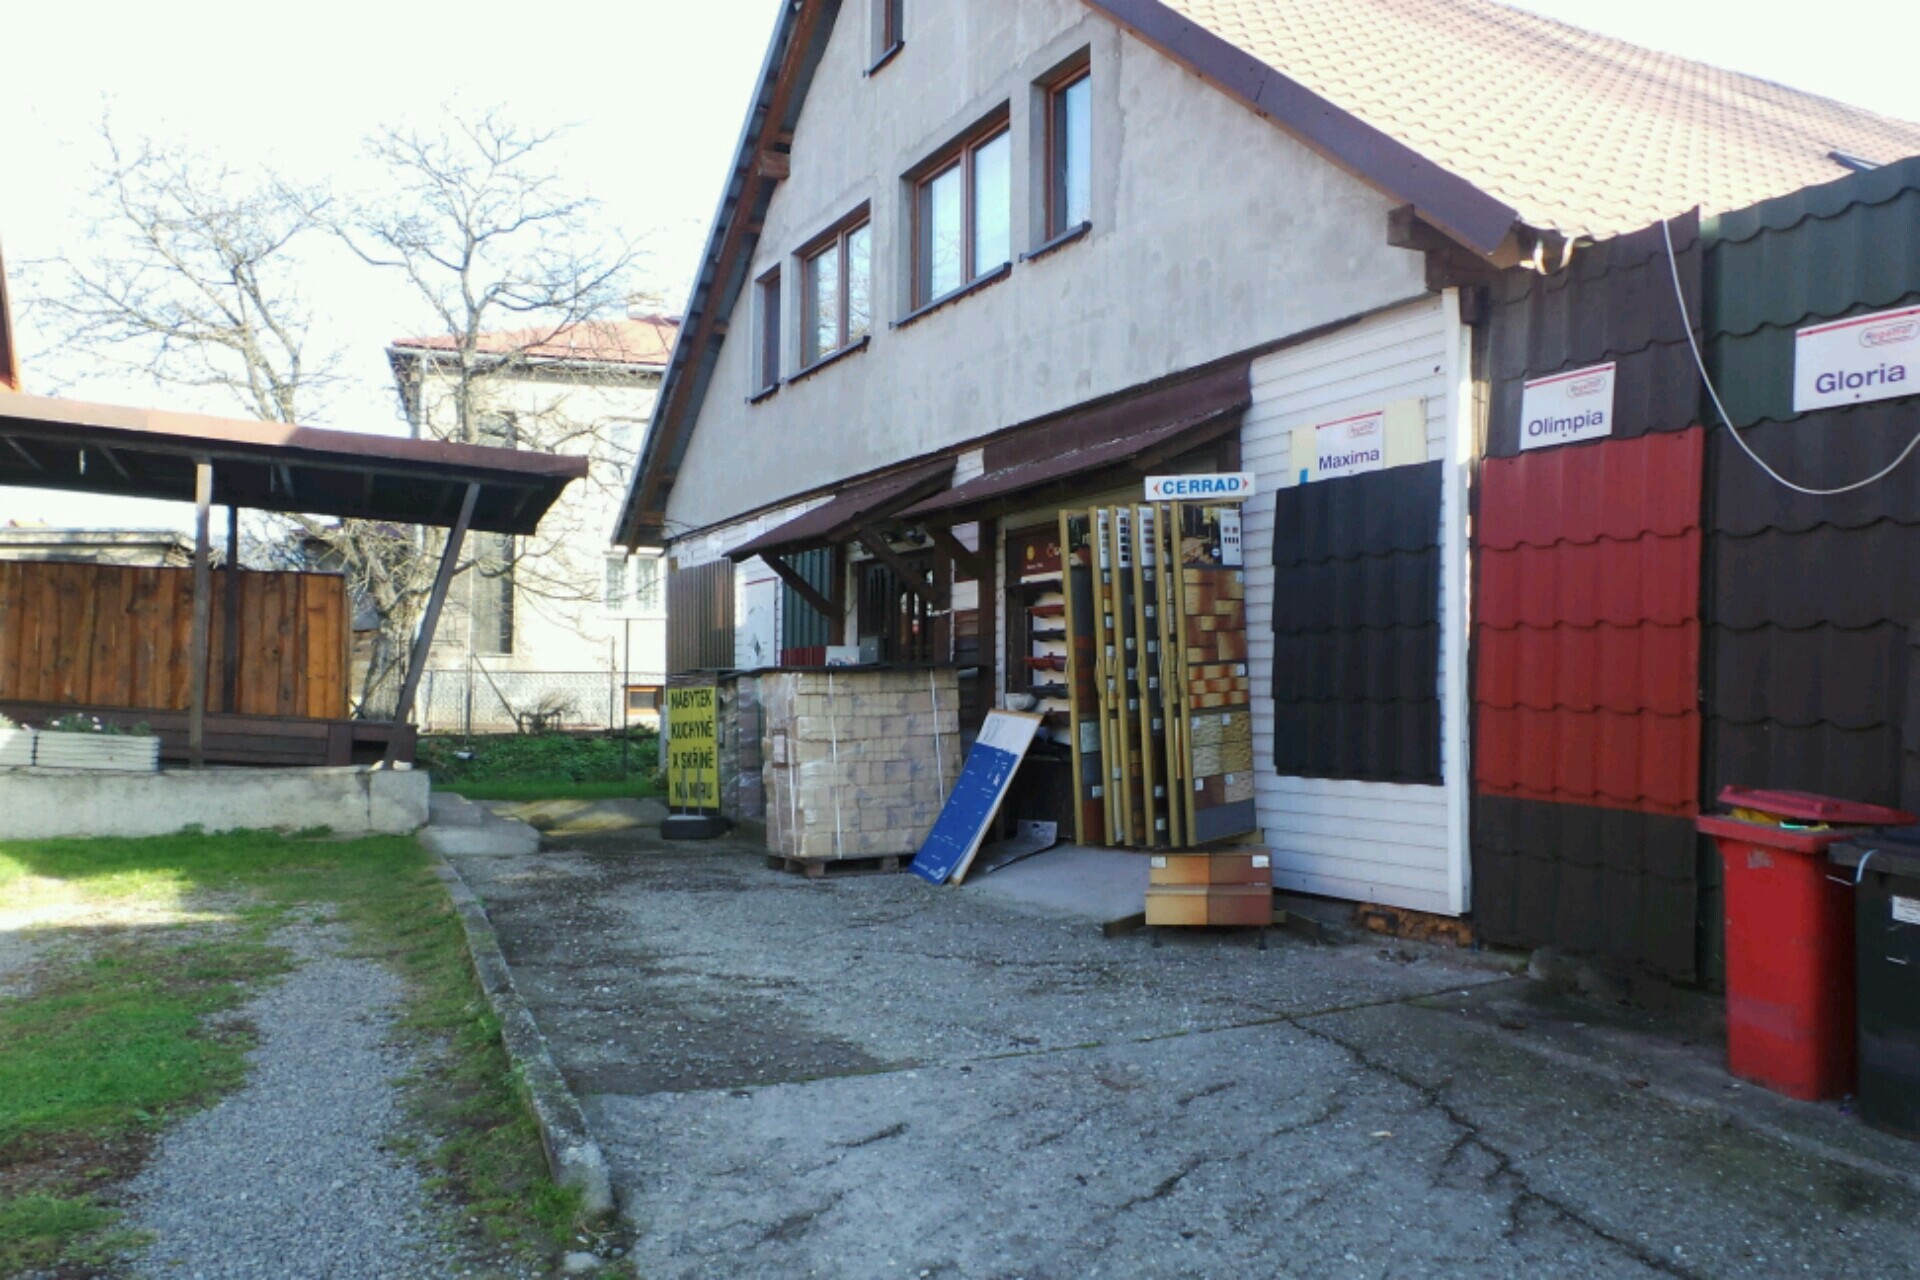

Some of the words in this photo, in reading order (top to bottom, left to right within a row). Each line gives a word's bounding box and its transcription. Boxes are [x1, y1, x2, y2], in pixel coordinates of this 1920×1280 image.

[1815, 363, 1906, 394] Gloria
[1528, 409, 1604, 437] Olimpia
[1319, 448, 1380, 471] Maxima
[1162, 477, 1240, 495] CERRAD
